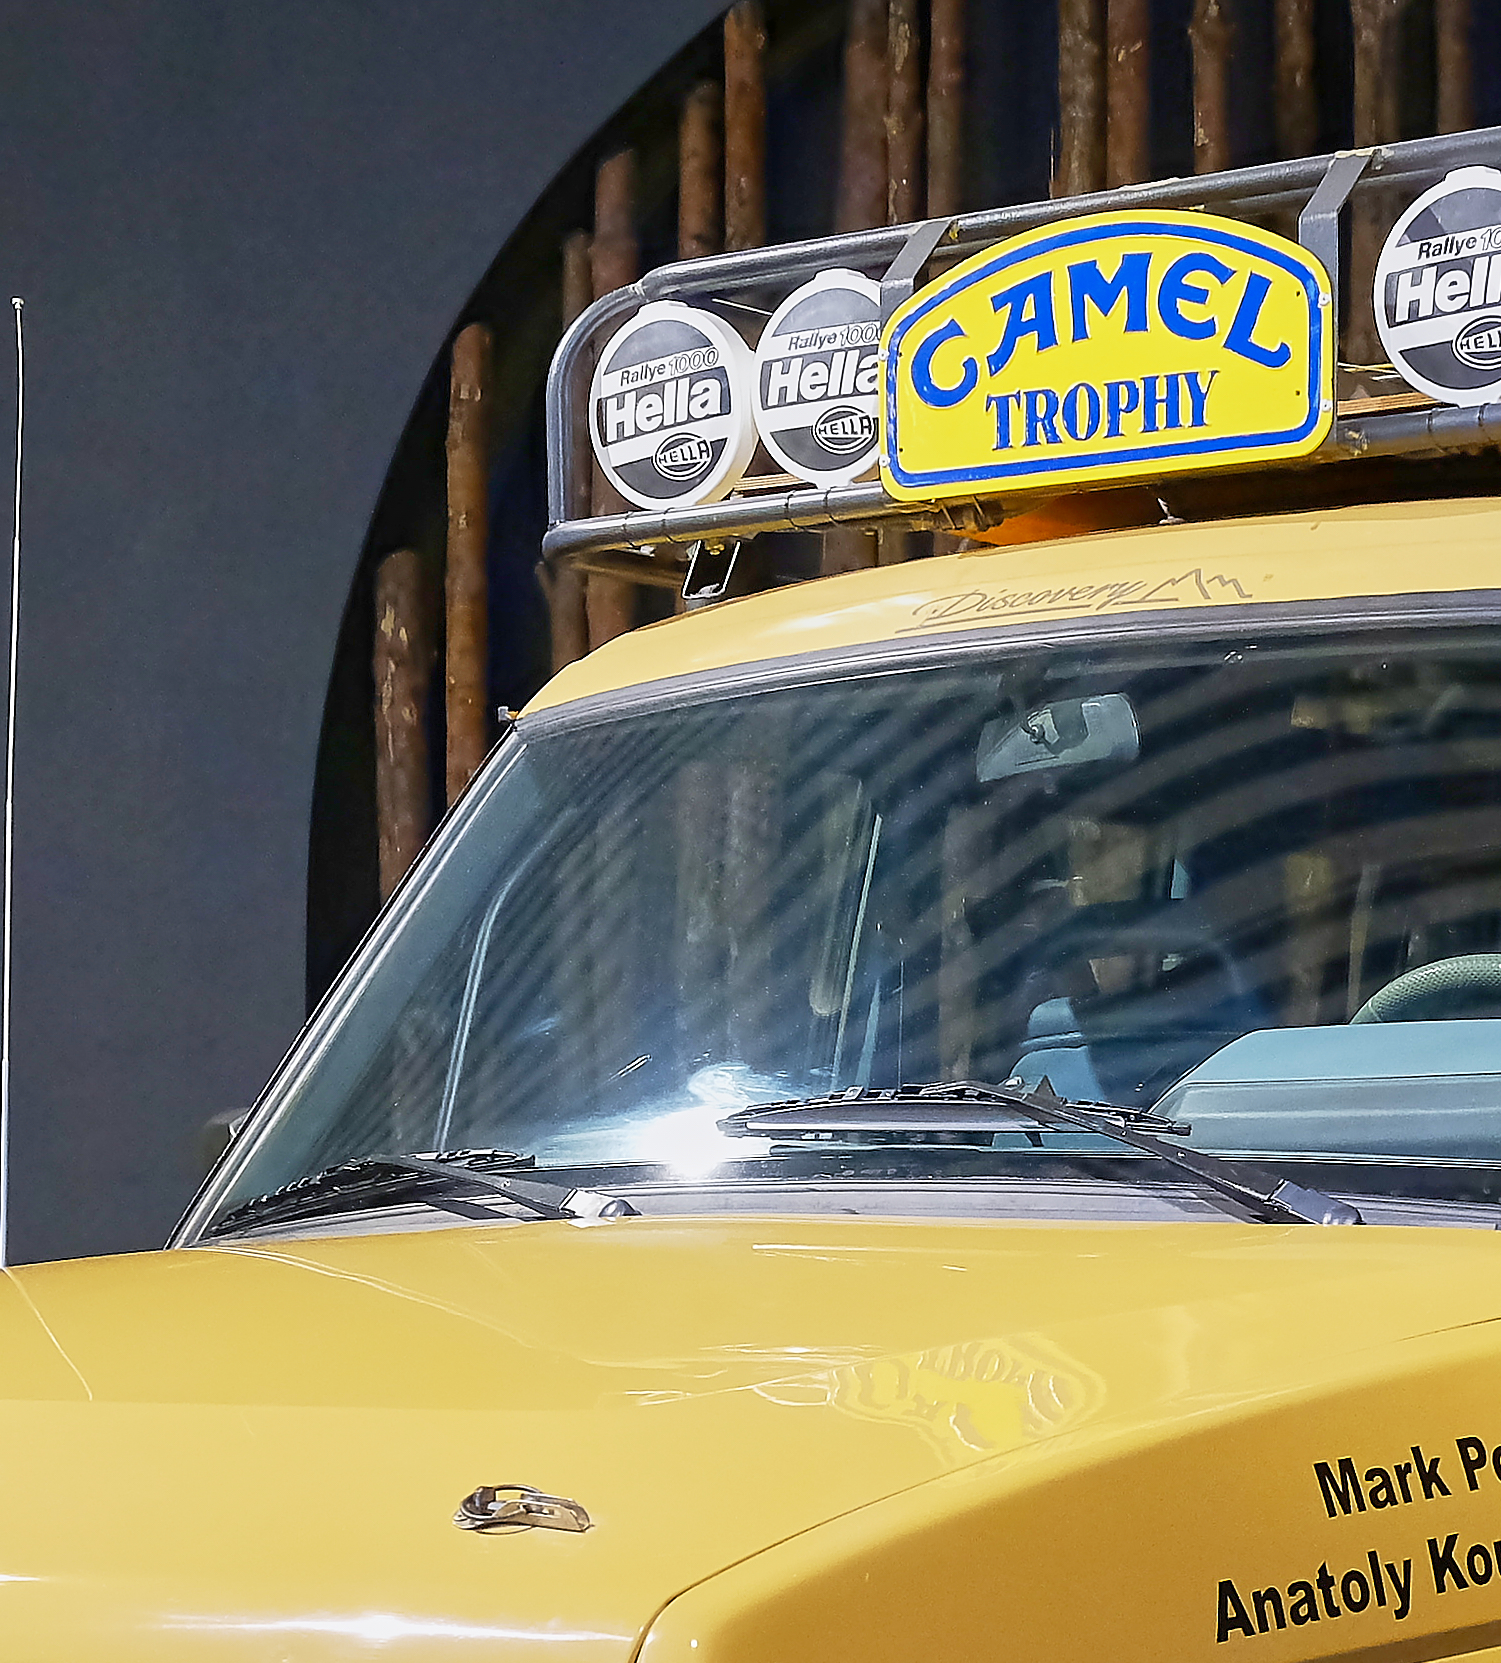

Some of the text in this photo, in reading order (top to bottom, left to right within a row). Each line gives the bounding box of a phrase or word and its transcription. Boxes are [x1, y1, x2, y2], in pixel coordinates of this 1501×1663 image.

[1417, 236, 1477, 260] Rallye
[788, 323, 881, 351] Rallye 100
[911, 252, 1292, 408] CAMEL
[620, 347, 719, 387] Rallye 1000
[767, 350, 880, 407] Hella
[605, 377, 722, 443] Hella
[817, 414, 873, 438] HELLA
[985, 370, 1221, 451] TROPHY
[658, 440, 711, 465] HELLA
[911, 579, 1148, 621] Discovery
[1312, 1444, 1452, 1519] Mark
[1215, 1549, 1412, 1644] Anatoly
